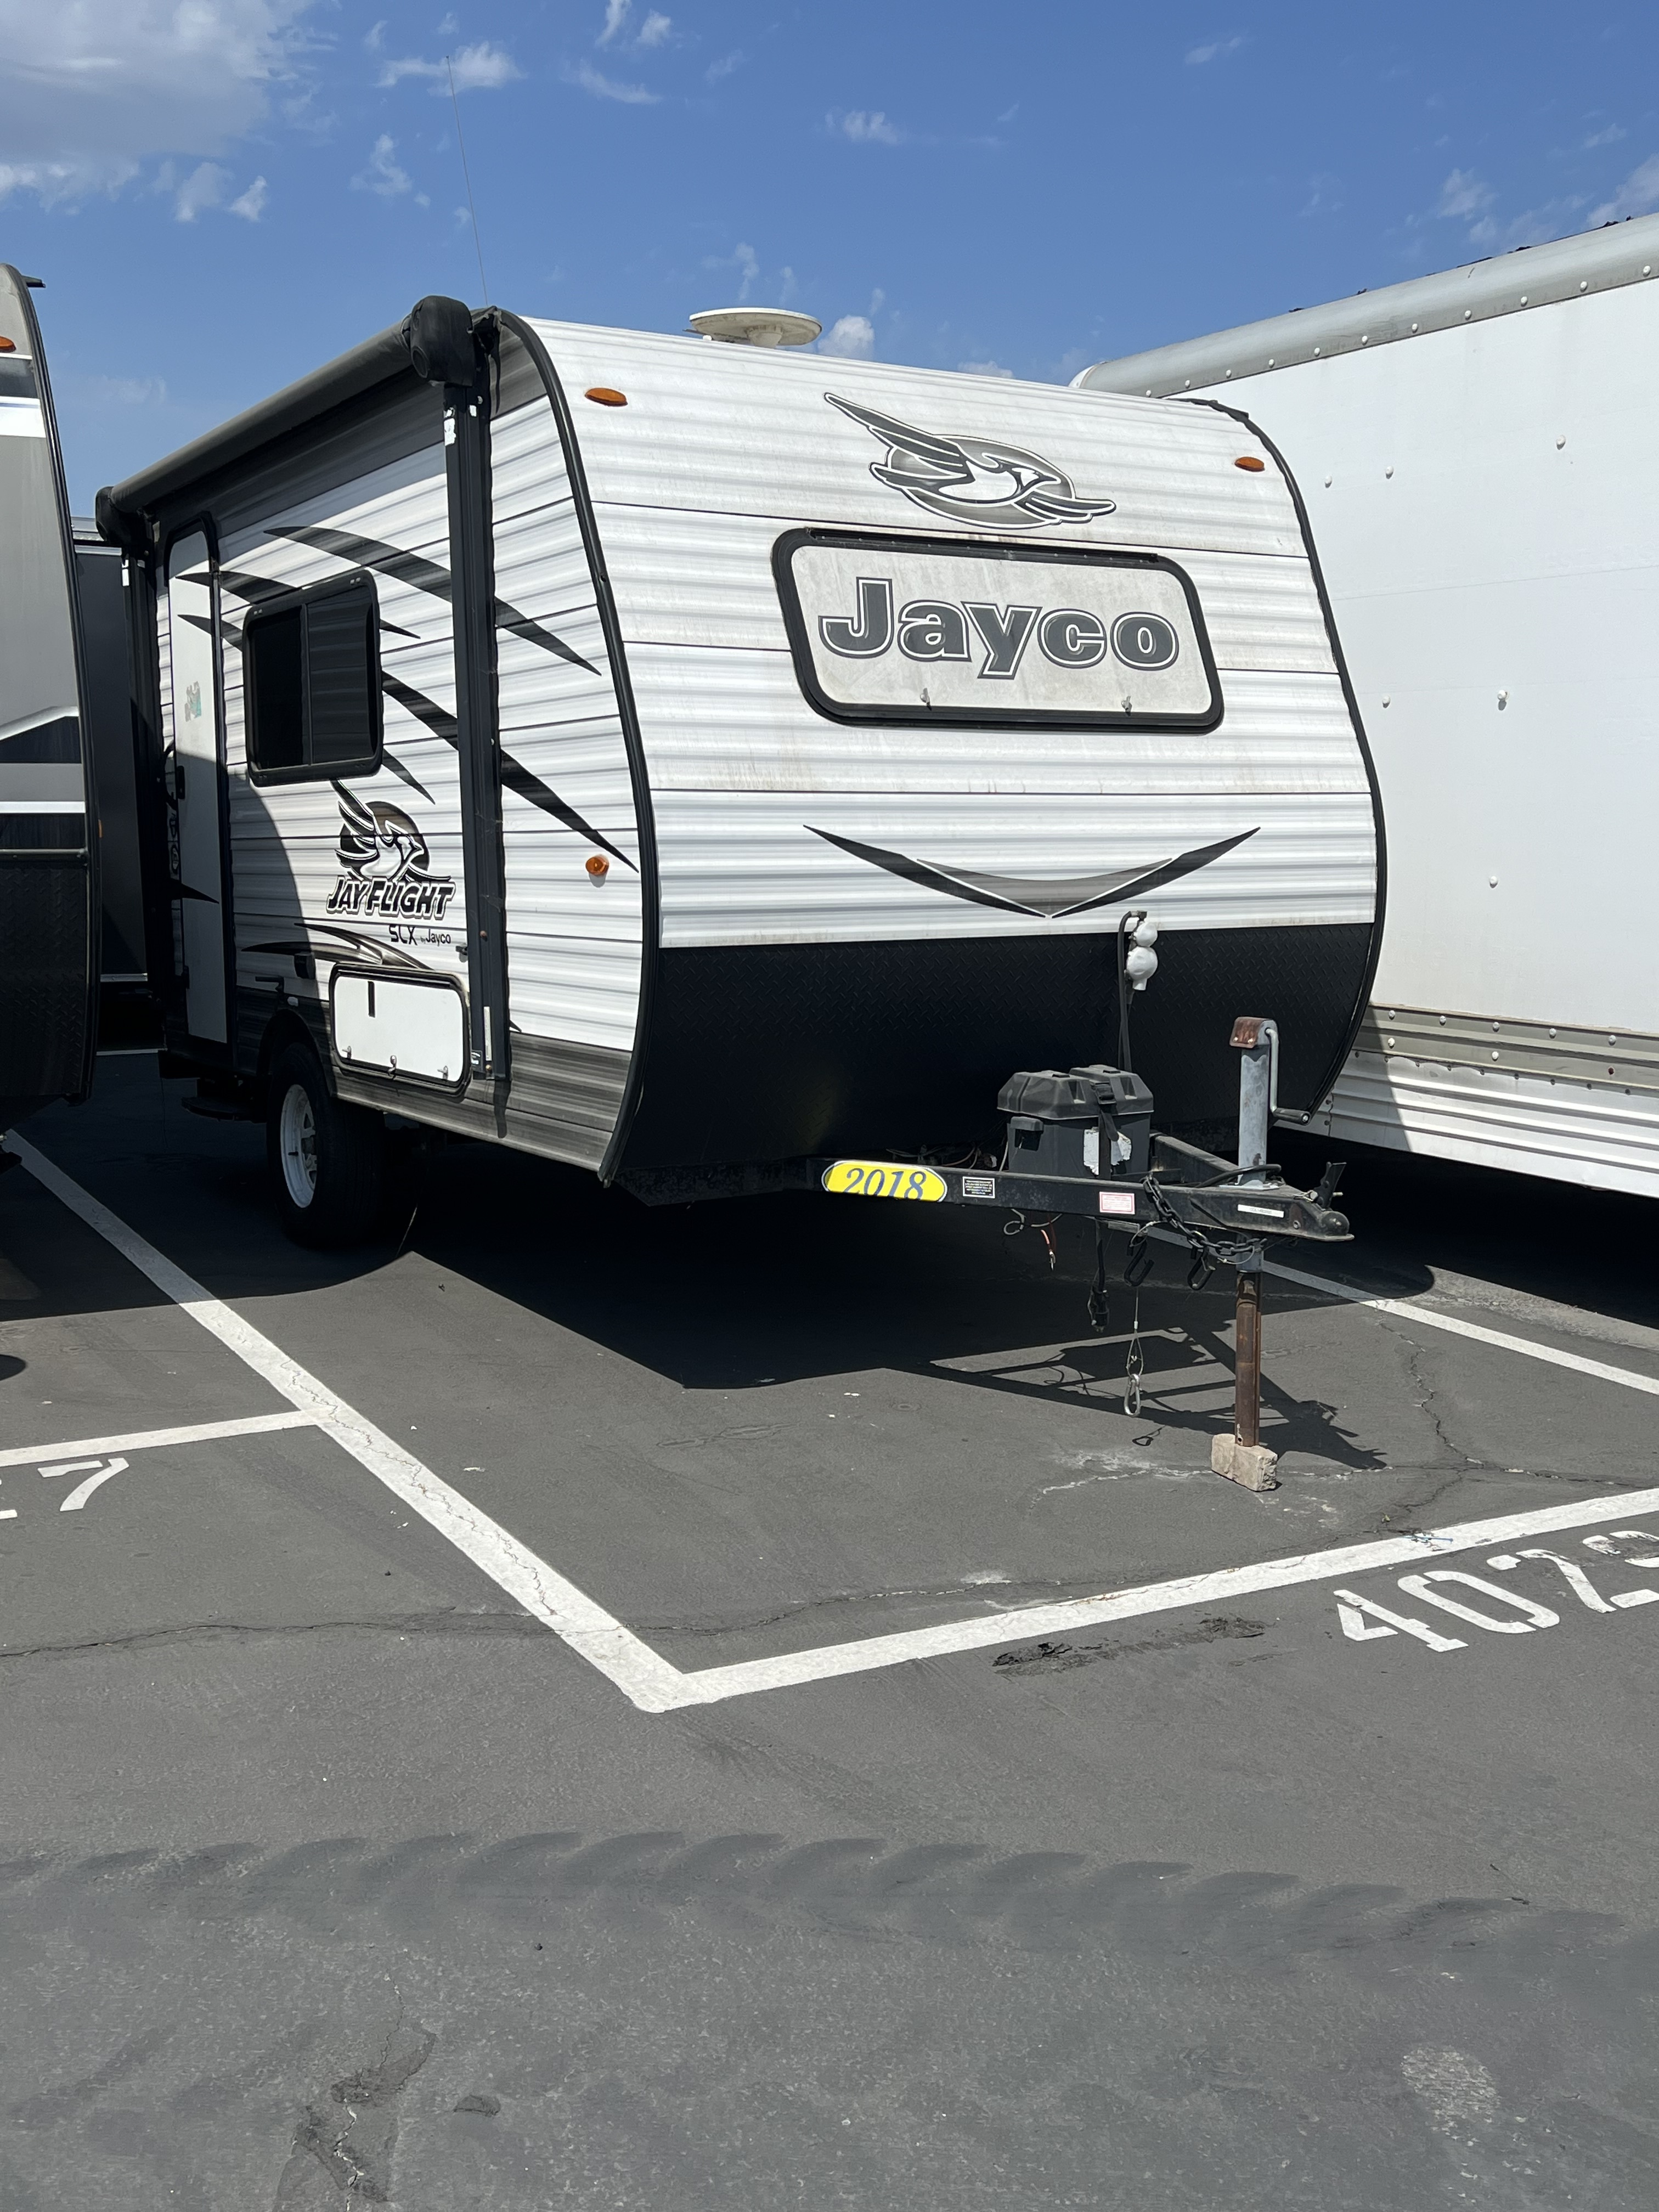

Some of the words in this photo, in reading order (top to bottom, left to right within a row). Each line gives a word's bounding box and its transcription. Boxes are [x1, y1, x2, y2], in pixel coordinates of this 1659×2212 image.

[819, 577, 1179, 679] Jayco
[389, 924, 417, 945] SLX
[426, 928, 451, 946] Jayco
[843, 1168, 927, 1200] 2018
[0, 1458, 129, 1519] 7
